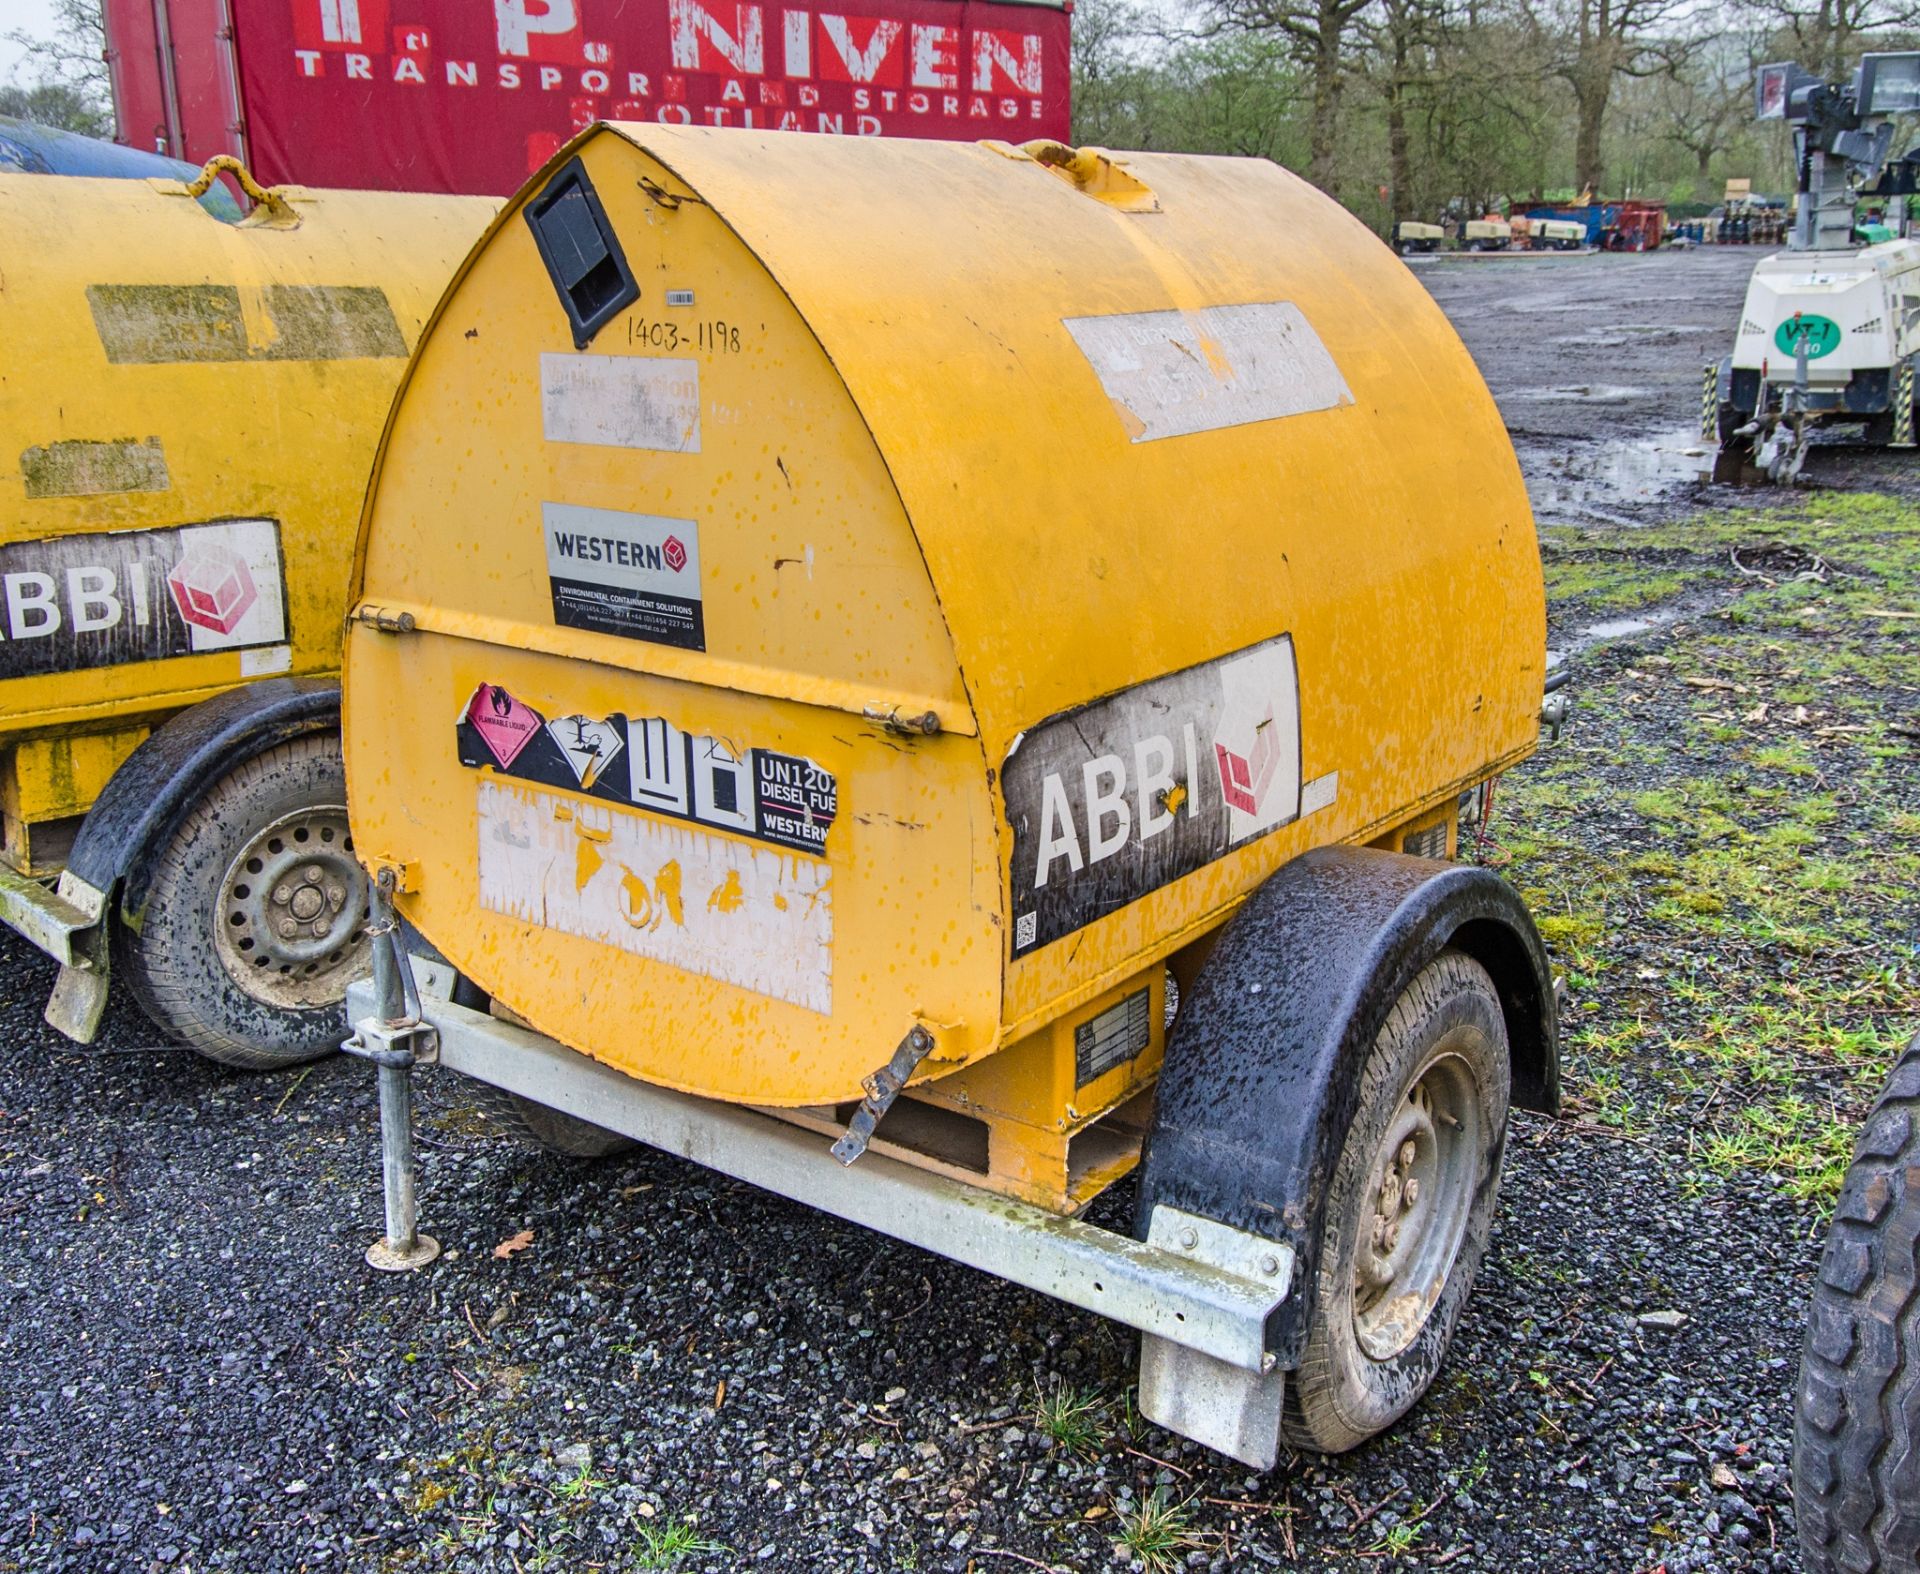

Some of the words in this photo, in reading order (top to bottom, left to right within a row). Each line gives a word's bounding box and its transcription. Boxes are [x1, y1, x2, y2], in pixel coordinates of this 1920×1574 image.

[669, 0, 1043, 94] NIVEN
[295, 50, 684, 99] TRANSPOR
[854, 89, 1042, 119] STORAGE
[628, 316, 741, 353] 1403-1198
[554, 531, 662, 571] WESTERN
[0, 562, 149, 642] BBI
[559, 586, 609, 602] ENVIRONMENTAL
[610, 594, 655, 608] CONTAINMENT
[655, 602, 693, 615] SOLUTIONS
[478, 715, 509, 728] FLAMMABLE
[509, 721, 526, 731] LIQUID
[502, 748, 507, 757] 3
[760, 780, 808, 806] DIESEL
[1034, 723, 1200, 889] ABBI
[763, 812, 829, 843] WESTERN
